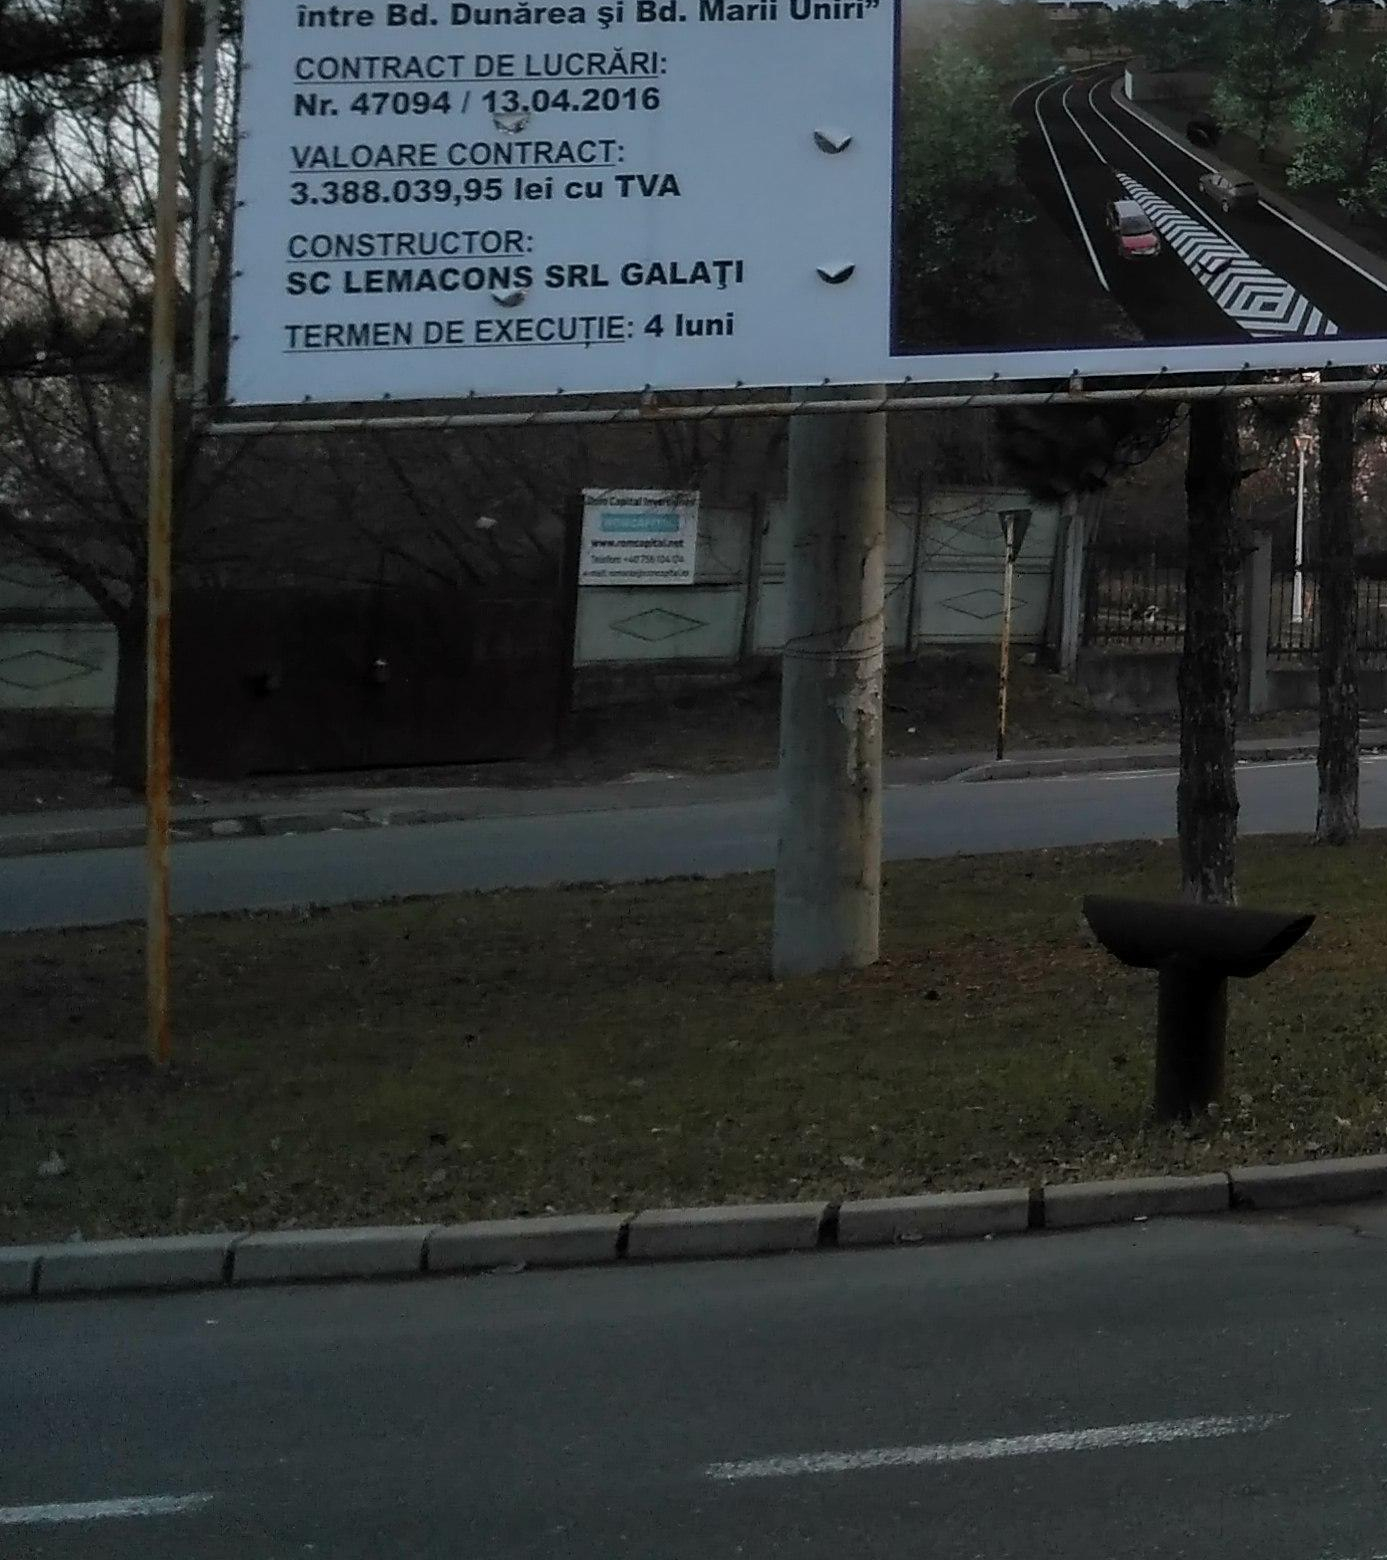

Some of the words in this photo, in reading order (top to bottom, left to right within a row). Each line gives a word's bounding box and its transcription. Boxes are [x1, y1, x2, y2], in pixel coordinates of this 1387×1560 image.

[296, 4, 375, 28] între
[386, 3, 439, 27] Bd.
[450, 1, 586, 26] Dunărea
[636, 0, 687, 23] Bd.
[295, 54, 466, 80] CONTRACT
[474, 53, 515, 78] DE
[525, 46, 667, 78] LUCRĂRI:
[294, 92, 338, 117] Nr.
[349, 90, 452, 116] 47094
[460, 90, 472, 115] /
[482, 86, 660, 115] 13.04.2016
[290, 143, 438, 169] VALOARE
[447, 139, 624, 167] CONTRACT:
[289, 177, 503, 207] 3.388.039,95
[514, 176, 554, 201] lei
[564, 181, 603, 200] cu
[614, 173, 681, 198] TVA
[288, 229, 534, 259] CONSTRUCTOR:
[285, 270, 331, 296] SC
[343, 265, 534, 295] LEMACONS
[544, 263, 610, 289] SRL
[284, 321, 413, 349] TERMEN
[423, 319, 465, 345] DE
[643, 313, 665, 338] 4
